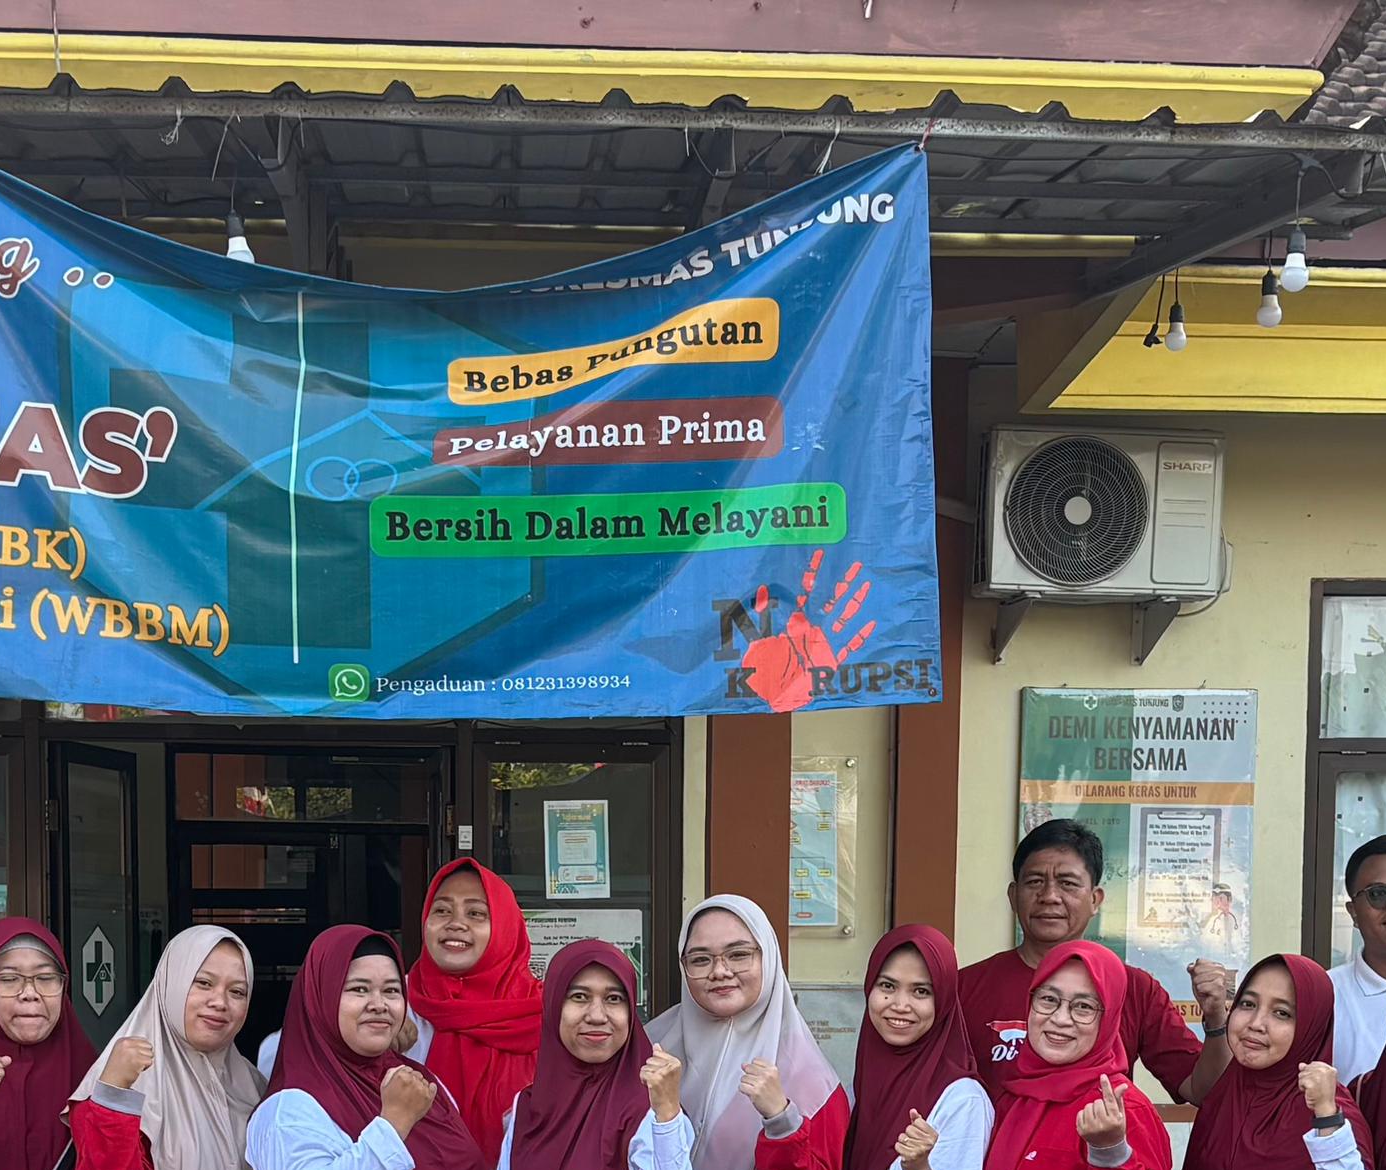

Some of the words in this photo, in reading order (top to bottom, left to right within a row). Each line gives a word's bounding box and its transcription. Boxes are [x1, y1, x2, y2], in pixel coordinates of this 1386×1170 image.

[721, 192, 894, 267] TUNUNG
[463, 364, 573, 394] Bebas
[584, 318, 764, 374] Pungutan
[446, 422, 646, 458] Pelayanan
[658, 411, 767, 446] Prima
[1163, 461, 1212, 471] SHARP
[385, 508, 514, 542] Bersih
[524, 504, 646, 541] Dalam
[657, 495, 831, 538] Melayani
[30, 591, 231, 658] (WBBM)
[376, 674, 485, 696] Pengaduan
[502, 675, 631, 691] 081231398934
[1049, 716, 1096, 739] DEMI
[1103, 717, 1236, 741] KENYAMANAN
[1094, 748, 1188, 771] BERSAMA
[1129, 785, 1161, 798] KERAS
[1164, 786, 1198, 798] UNTUK
